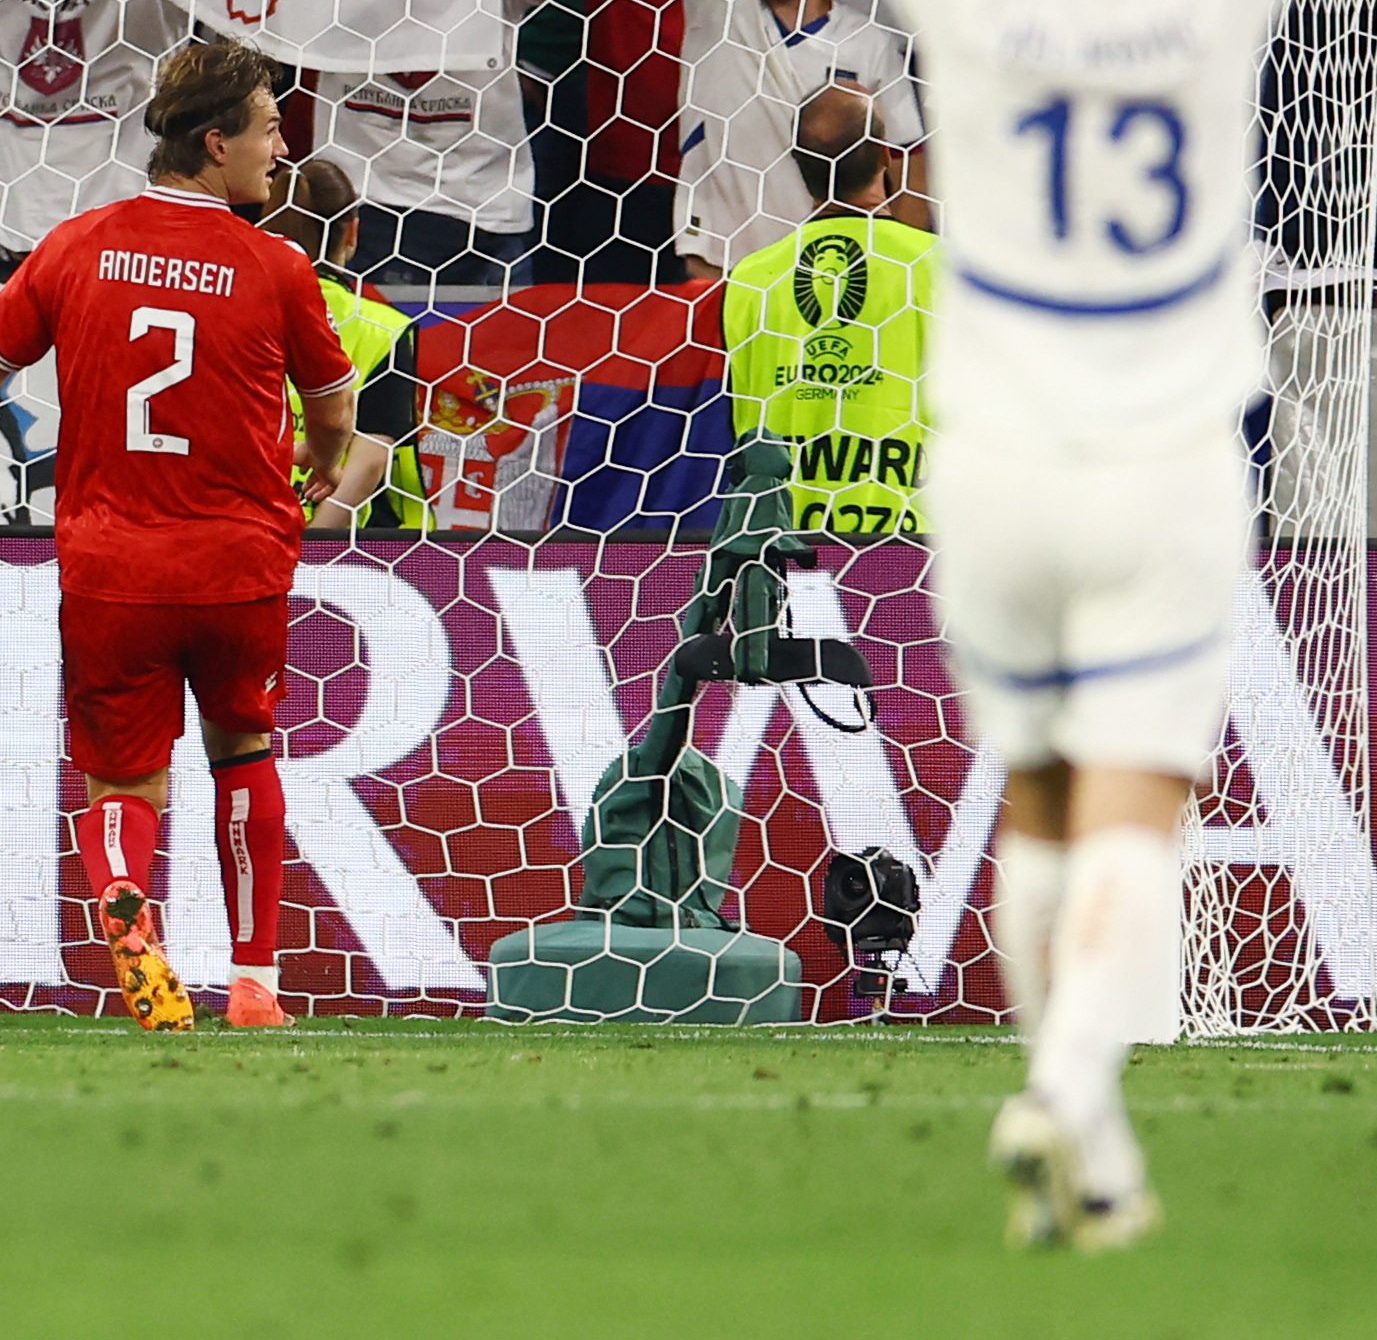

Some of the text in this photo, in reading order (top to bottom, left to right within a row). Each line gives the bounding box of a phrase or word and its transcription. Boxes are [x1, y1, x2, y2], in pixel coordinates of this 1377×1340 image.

[1015, 97, 1188, 255] 13
[99, 249, 235, 298] ANDERSEN
[125, 306, 196, 456] 2
[805, 339, 850, 358] UEFA
